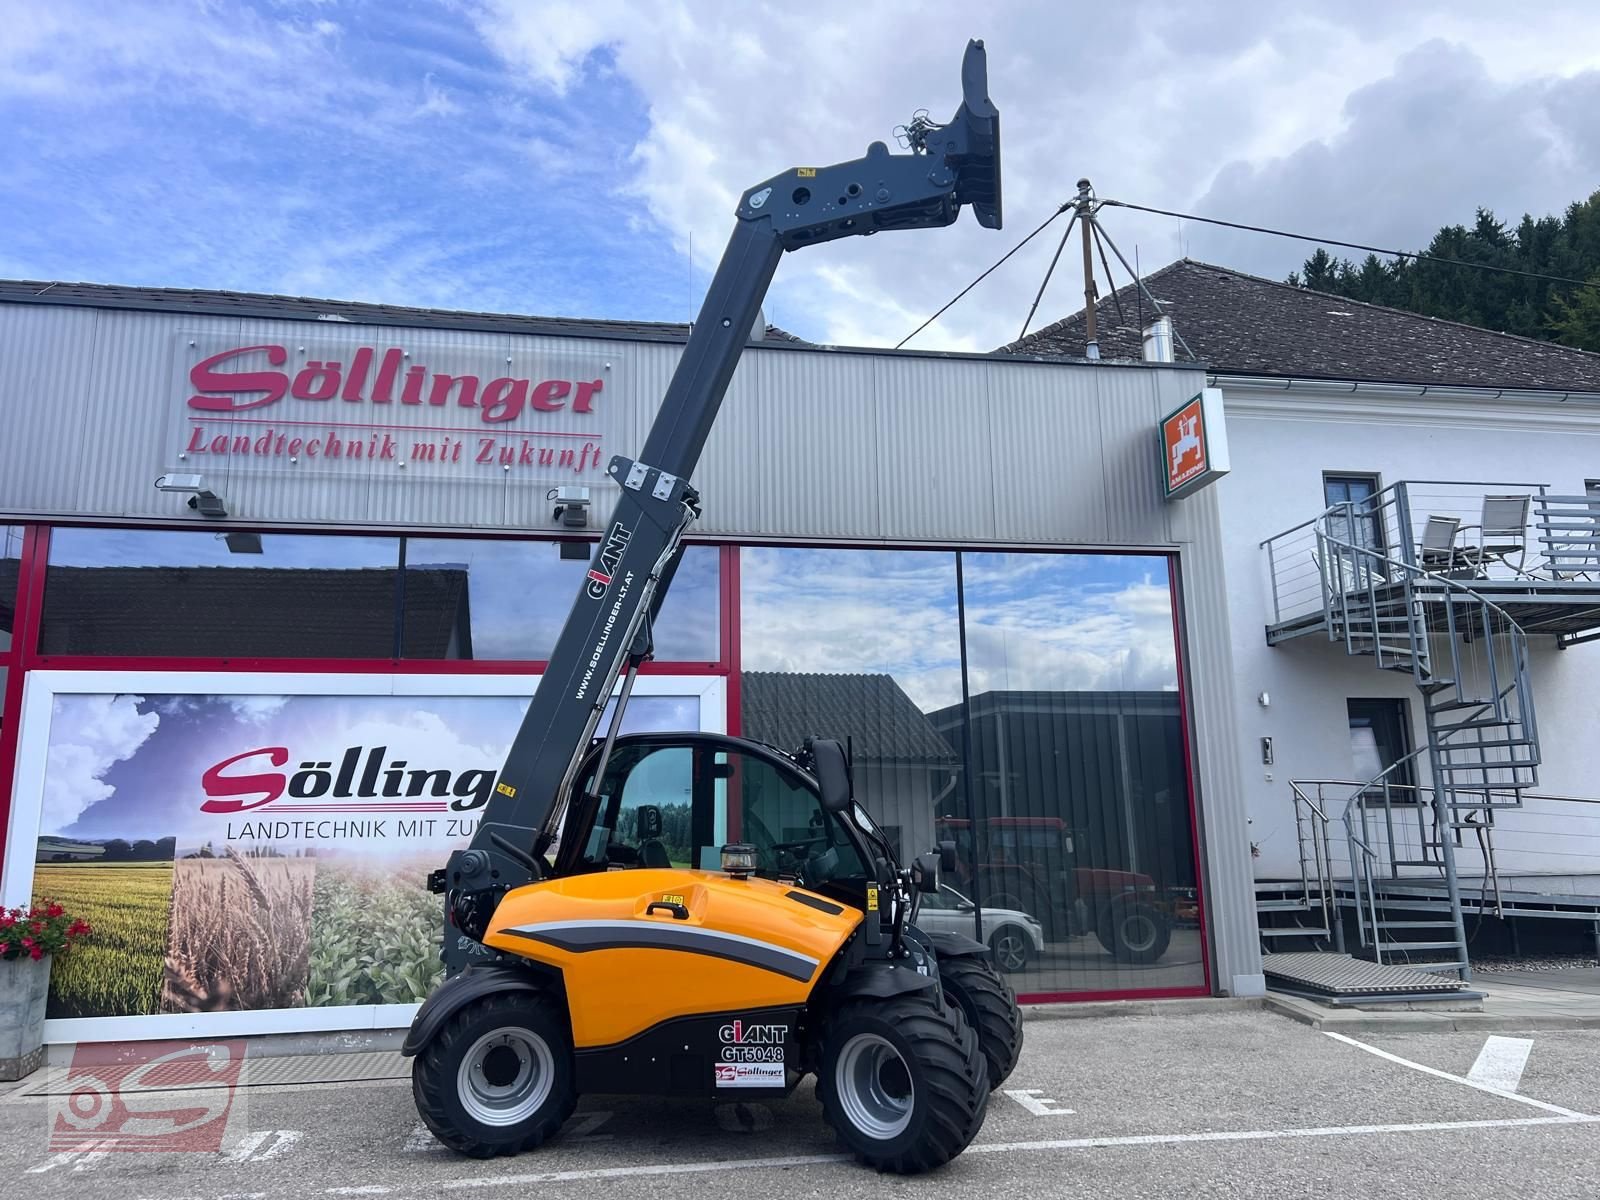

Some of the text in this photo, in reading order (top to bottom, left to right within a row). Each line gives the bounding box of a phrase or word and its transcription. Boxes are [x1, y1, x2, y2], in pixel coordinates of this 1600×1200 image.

[188, 345, 603, 424] Söllinger
[186, 427, 602, 474] Landtechnik mit Zukunft
[575, 570, 634, 700] WWW.SOELLINGER-LT.AT
[226, 820, 386, 840] LANDTECHNIK
[398, 820, 437, 837] MIT
[721, 1046, 785, 1062] GT5048
